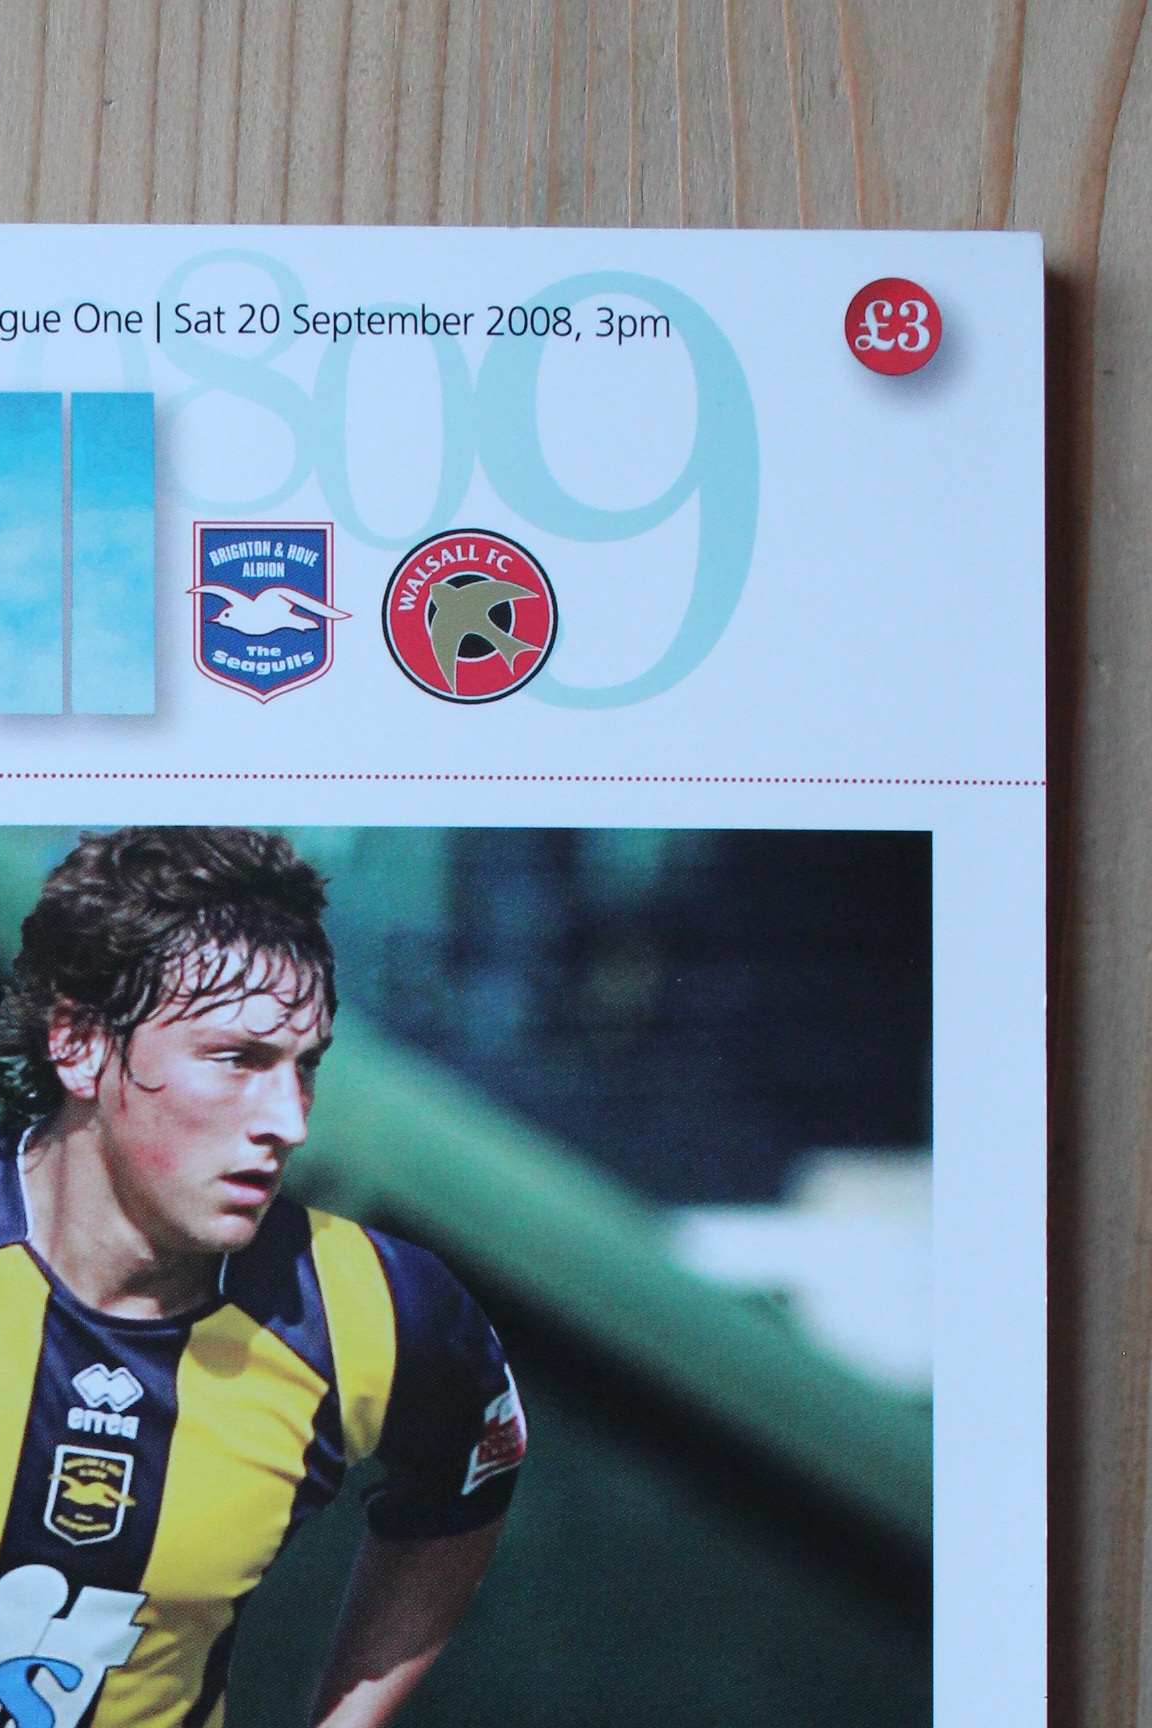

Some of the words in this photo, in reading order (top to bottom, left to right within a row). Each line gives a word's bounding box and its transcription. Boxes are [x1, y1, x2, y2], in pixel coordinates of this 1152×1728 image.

[73, 302, 143, 334] One
[174, 303, 226, 334] Sat
[238, 303, 280, 334] 20
[293, 303, 475, 341] September
[486, 306, 581, 343] 2008,
[595, 306, 671, 346] 3pm
[854, 299, 930, 352] £3
[208, 541, 271, 567] BRIGHTON
[274, 542, 284, 557] &
[287, 543, 320, 568] HOVE
[242, 562, 285, 578] ALBION
[398, 544, 480, 612] WALSALL
[486, 547, 513, 573] FC
[212, 649, 315, 675] Seagulls
[246, 645, 282, 657] The
